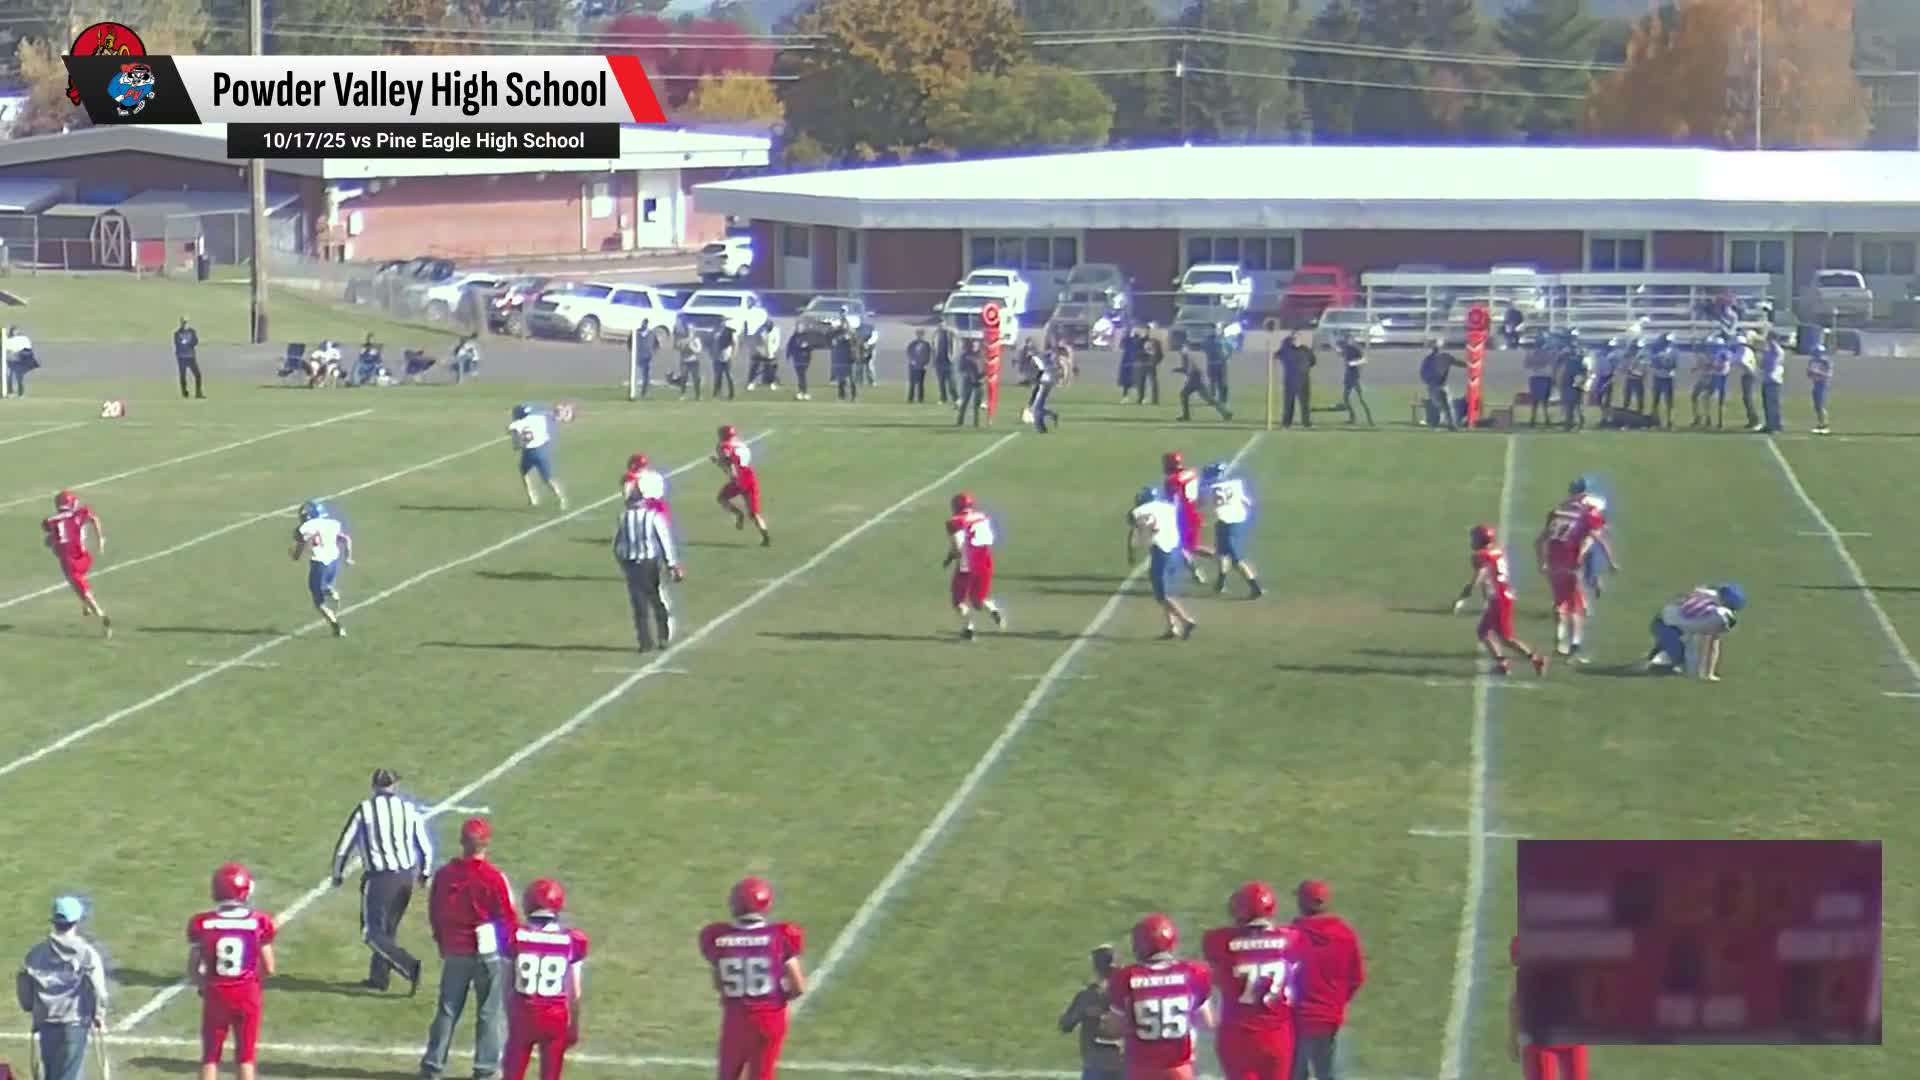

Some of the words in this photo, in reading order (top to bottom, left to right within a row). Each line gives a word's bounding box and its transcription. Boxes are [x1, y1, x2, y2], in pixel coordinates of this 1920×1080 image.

[101, 400, 121, 417] 20
[215, 936, 244, 977] 8
[514, 952, 568, 996] 88
[718, 957, 774, 997] 56
[1231, 960, 1285, 1005] 77
[1133, 995, 1189, 1040] 55
